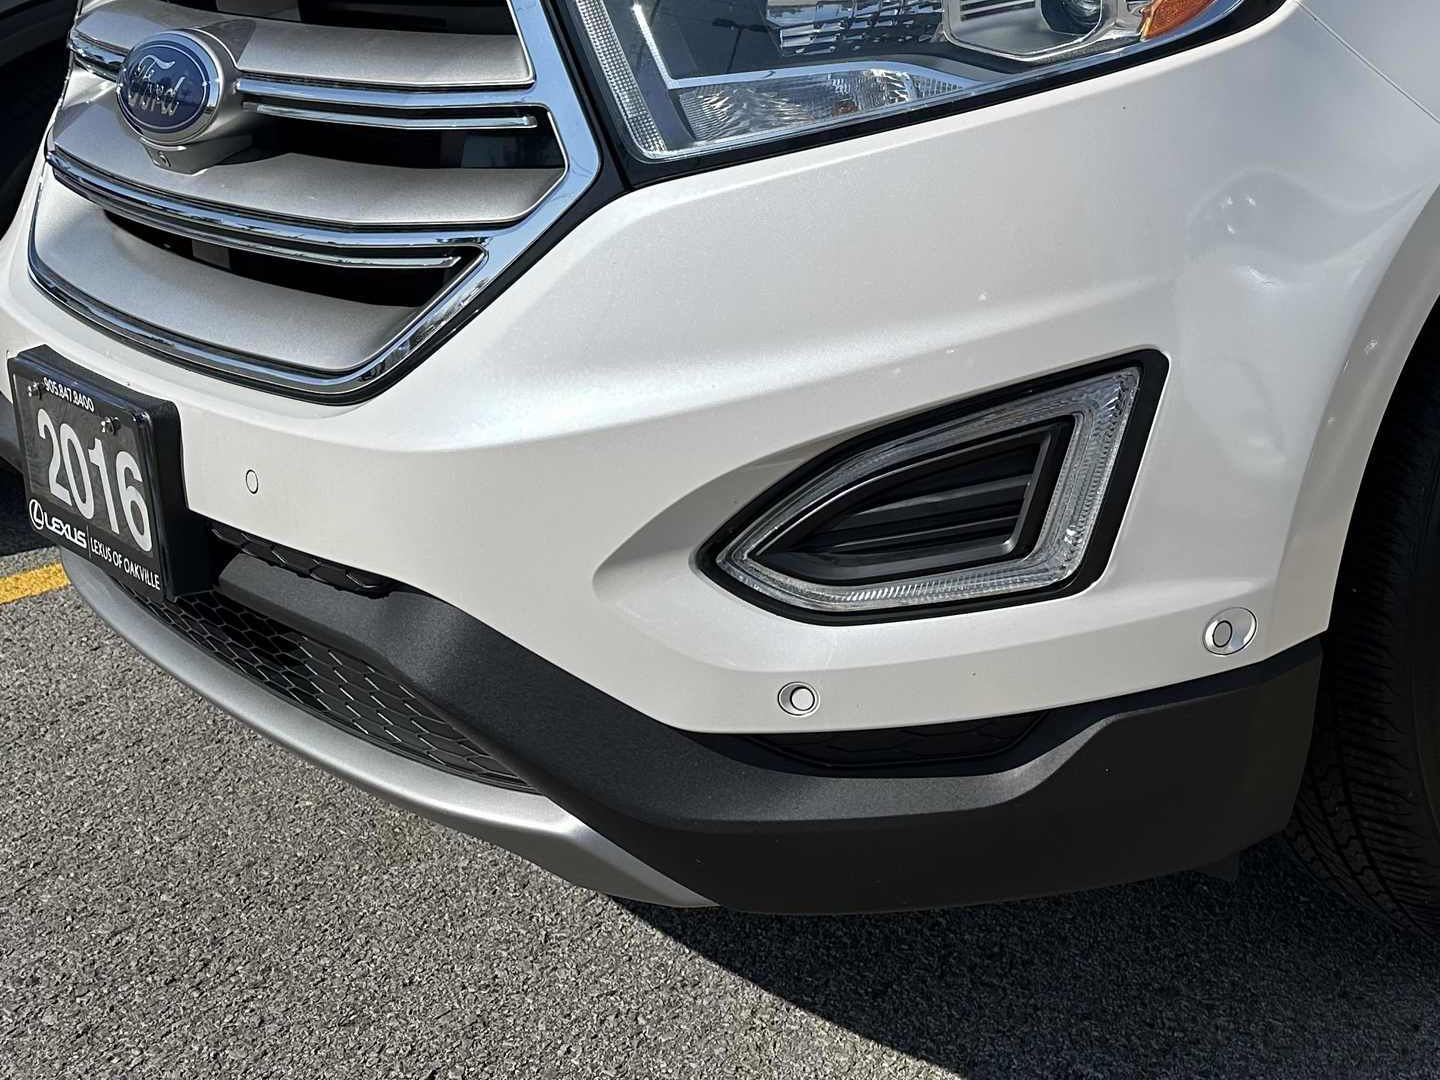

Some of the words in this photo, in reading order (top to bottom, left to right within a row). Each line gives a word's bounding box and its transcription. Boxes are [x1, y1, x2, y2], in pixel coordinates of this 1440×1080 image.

[37, 408, 153, 552] 2016
[44, 511, 88, 549] LEXUS
[91, 536, 112, 562] LEXUS
[112, 551, 123, 568] OF
[123, 558, 160, 591] OAKVILLE
